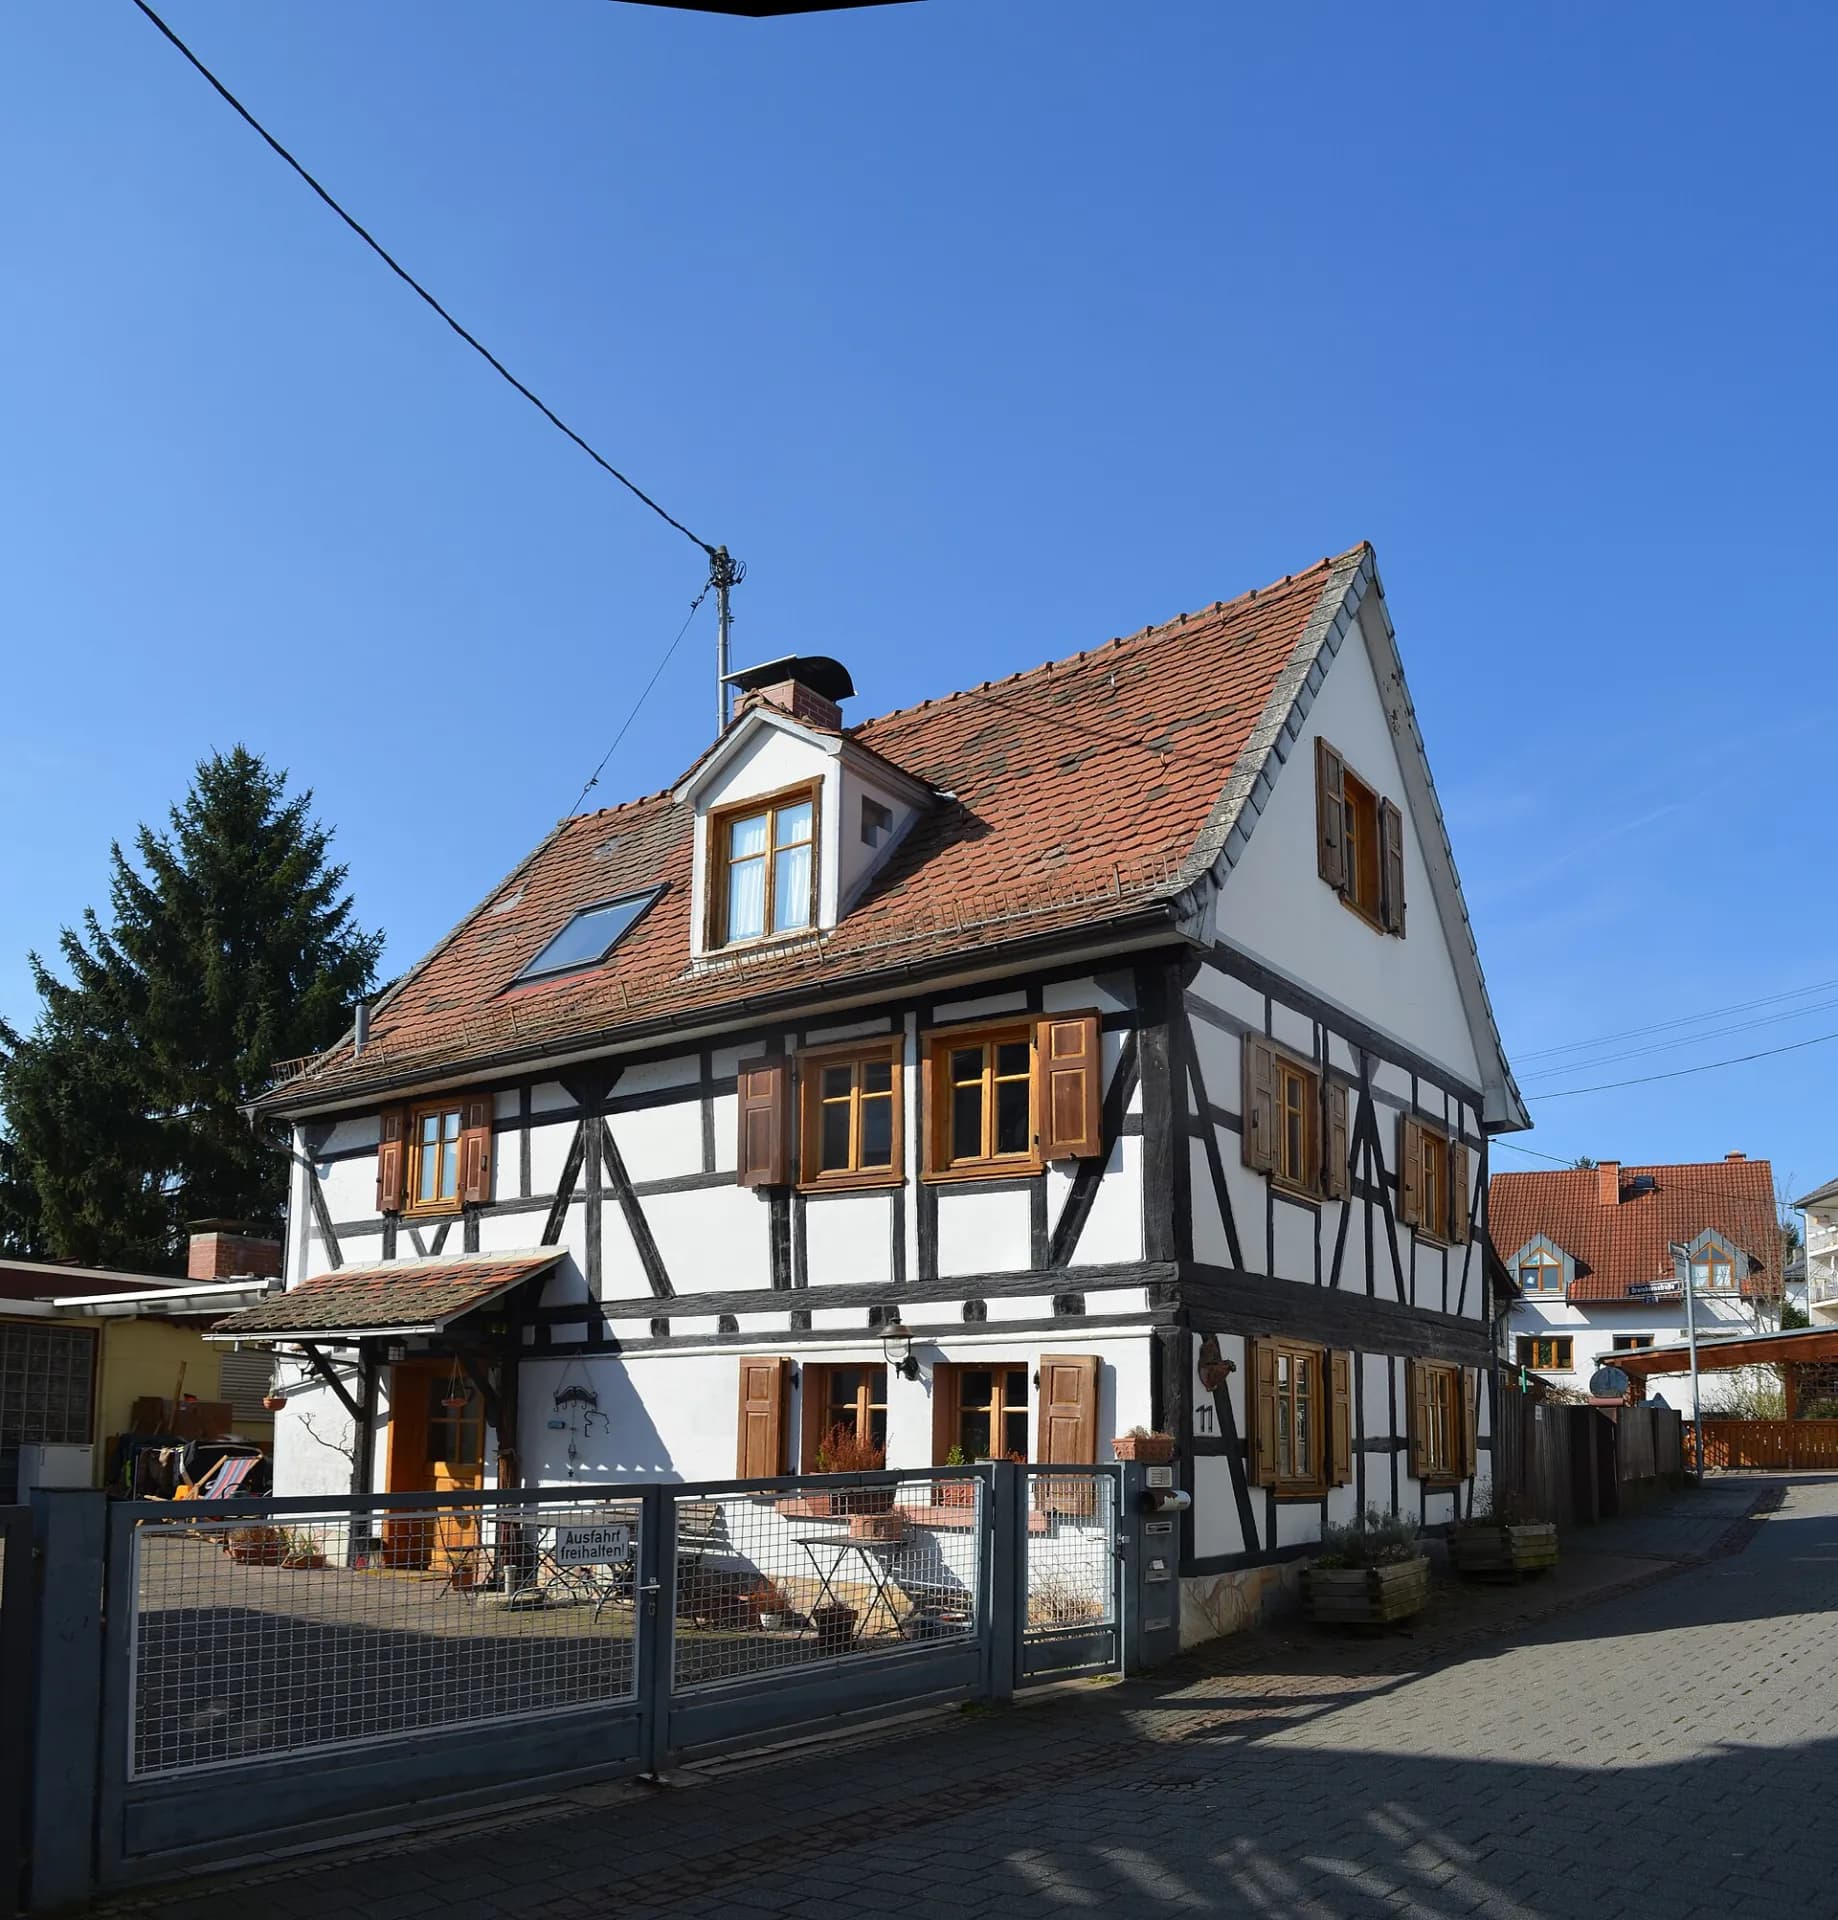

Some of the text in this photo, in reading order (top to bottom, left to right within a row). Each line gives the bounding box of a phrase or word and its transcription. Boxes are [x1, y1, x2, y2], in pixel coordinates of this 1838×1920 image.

[1195, 1404, 1213, 1433] 11
[565, 1529, 621, 1545] Ausfahrt
[560, 1543, 625, 1560] freihalten!
